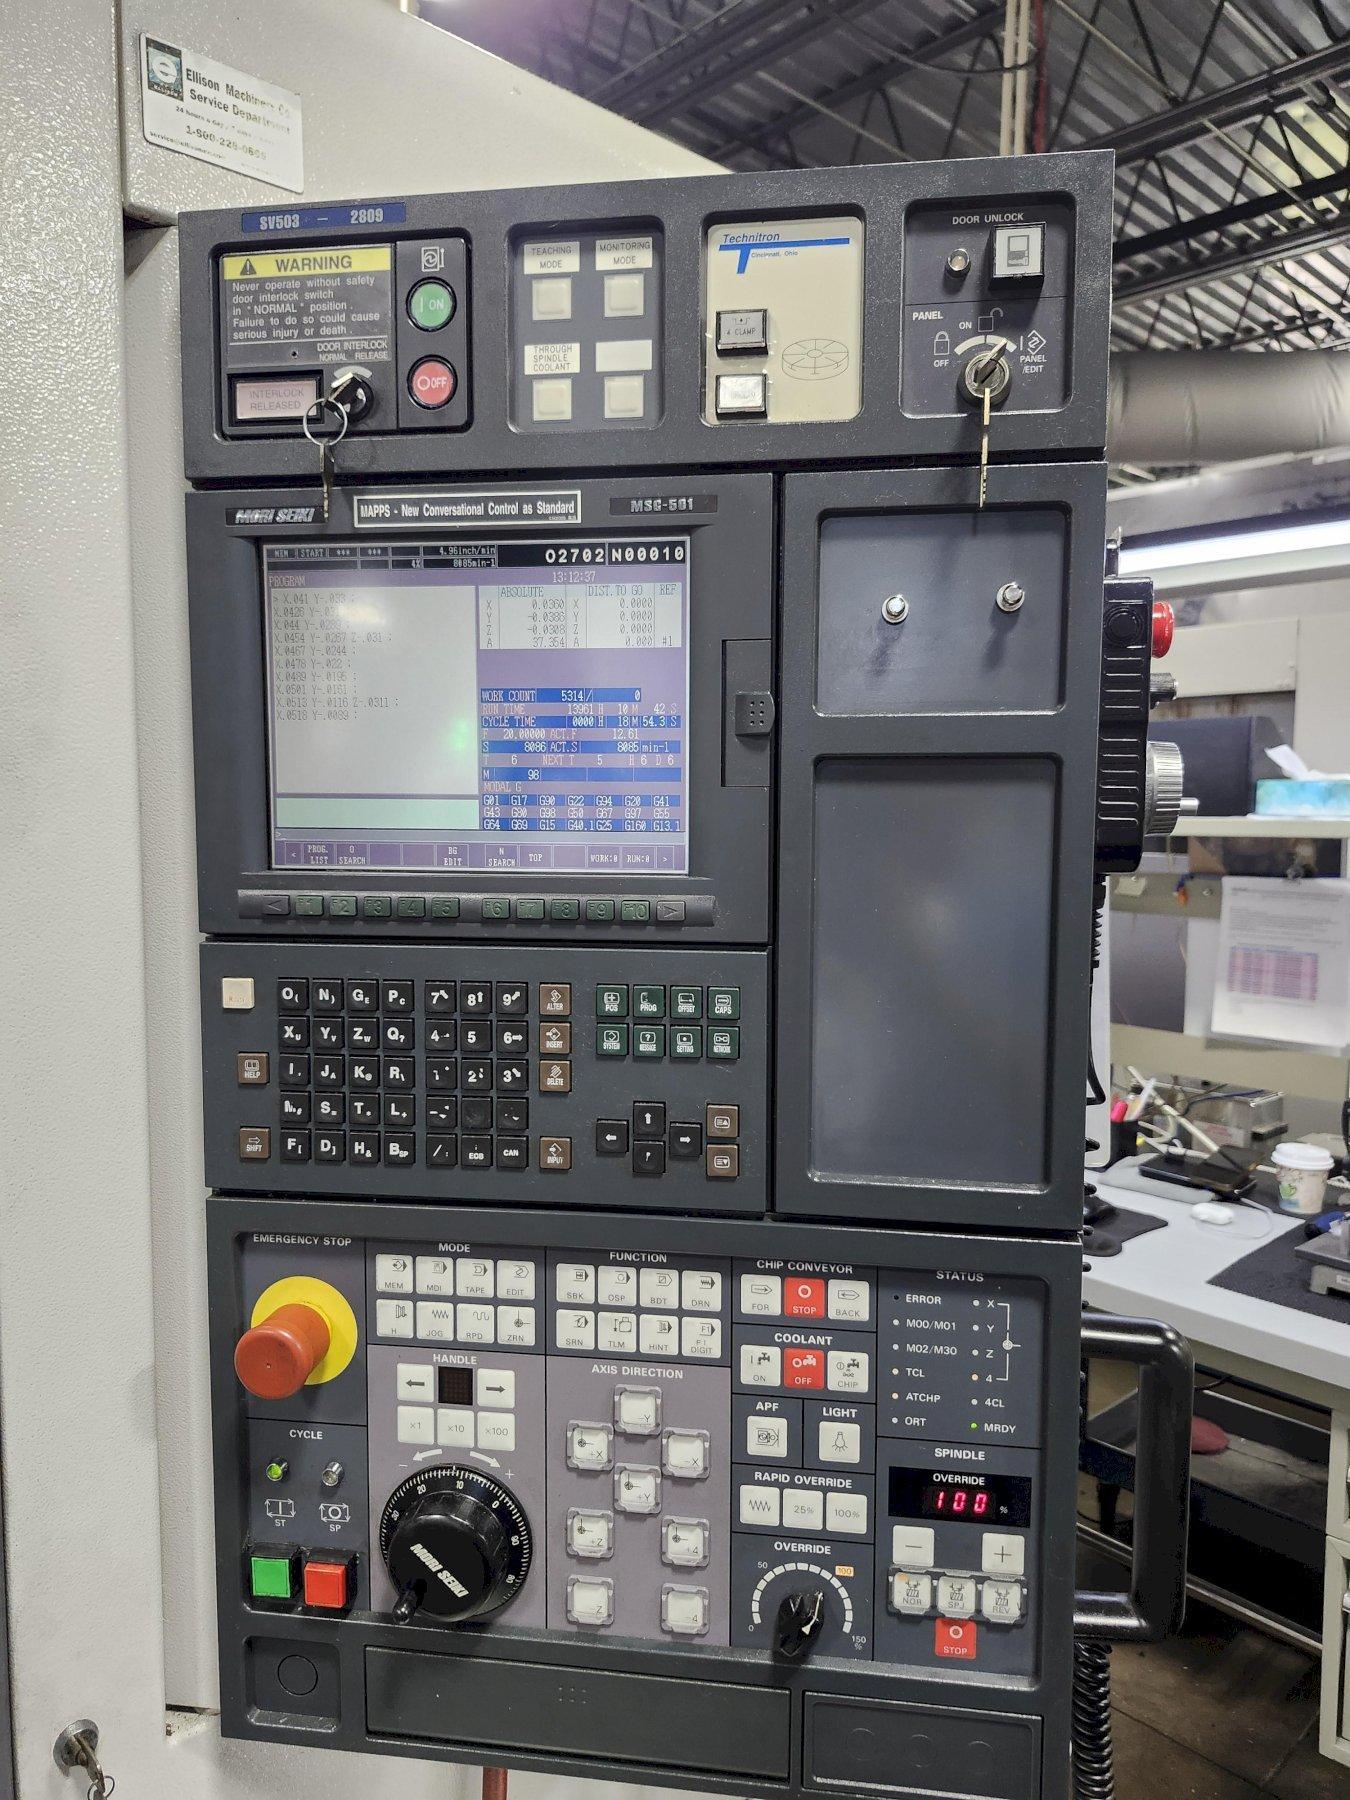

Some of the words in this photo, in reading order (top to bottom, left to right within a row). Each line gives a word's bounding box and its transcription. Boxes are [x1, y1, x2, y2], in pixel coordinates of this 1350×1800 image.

[185, 67, 220, 92] Ellison
[190, 88, 229, 113] Service
[260, 214, 300, 230] SV503
[350, 208, 384, 224] 2809
[952, 216, 980, 224] DOOR
[984, 212, 1024, 223] UNLOCK
[722, 232, 780, 244] Technitron
[531, 246, 572, 256] TEACHING
[600, 242, 650, 251] MONITORING
[276, 256, 352, 273] WARNING
[540, 260, 563, 268] MODE
[613, 256, 636, 265] MODE
[232, 282, 259, 292] Never
[265, 280, 300, 292] operate
[306, 276, 340, 287] without
[346, 276, 376, 287] safety
[232, 294, 254, 304] door
[259, 291, 299, 302] interlock
[304, 290, 334, 300] switch
[429, 300, 445, 310] ON
[232, 306, 242, 316] in
[912, 311, 944, 320] PANEL
[233, 317, 265, 328] Failure
[270, 316, 280, 326] to
[285, 316, 298, 325] do
[302, 316, 315, 324] so
[320, 312, 346, 324] could
[351, 312, 380, 322] cause
[958, 322, 972, 330] ON
[232, 330, 268, 340] serious
[272, 327, 299, 339] injury
[304, 328, 315, 336] or
[317, 342, 341, 352] DOOR
[344, 340, 388, 350] INTERLOCK
[534, 346, 572, 354] THROUGH
[319, 352, 348, 361] NORMAL
[355, 350, 388, 360] RELEASE
[533, 354, 568, 362] SPINDLE
[1020, 355, 1047, 364] PANEL
[533, 363, 570, 372] COOLANT
[934, 359, 950, 368] OFF
[1022, 365, 1044, 374] /EDIT
[431, 378, 448, 388] OFF
[250, 388, 304, 400] INTERLOCK
[250, 400, 302, 412] RELEASED
[360, 504, 391, 517] MAPPS
[401, 504, 420, 517] New
[423, 502, 484, 516] Conversational
[488, 501, 518, 516] Control
[522, 504, 533, 514] as
[536, 500, 575, 514] Standard
[630, 498, 694, 513] MSG-501
[235, 509, 274, 524] MORI
[275, 508, 316, 523] SEIKI
[274, 549, 289, 558] MEM
[300, 549, 325, 558] START
[611, 546, 685, 562] N00010
[268, 576, 306, 588] PROGRAM
[552, 571, 596, 583] 13:12:37
[500, 586, 544, 598] ABSOLUTE
[632, 585, 644, 596] GO
[659, 584, 676, 596] REF
[482, 690, 504, 700] WORK
[508, 690, 536, 700] COUNT
[482, 704, 499, 714] RUN
[504, 704, 525, 714] TIME
[568, 704, 594, 714] 13961
[482, 716, 509, 727] CYCLE
[514, 716, 536, 727] TIME
[642, 716, 666, 727] 54.3
[612, 729, 639, 740] 12.61
[550, 742, 578, 752] ACT.S
[511, 796, 528, 806] G17
[540, 796, 556, 806] G90
[568, 796, 584, 806] G22
[596, 796, 613, 806] G94
[624, 796, 641, 806] G20
[653, 796, 670, 806] G41
[310, 856, 328, 864] LIST
[338, 856, 366, 864] SEARCH
[444, 858, 462, 866] EDIT
[488, 859, 516, 867] SEARCH
[528, 854, 543, 862] TOP
[546, 1003, 564, 1011] ALTER
[605, 1004, 618, 1012] POS
[640, 1004, 657, 1012] PROG
[678, 1005, 695, 1014] OFFSET
[715, 1006, 732, 1015] CAPS
[603, 1042, 620, 1050] SYSTEM
[546, 1078, 564, 1086] DELETE
[246, 1144, 262, 1152] SHIFT
[253, 1233, 320, 1245] EMERGENCY
[324, 1236, 352, 1247] STOP
[438, 1242, 471, 1253] MODE
[609, 1251, 668, 1263] FUNCTION
[756, 1260, 784, 1270] CHIP
[788, 1261, 853, 1274] CONVEYOR
[936, 1270, 984, 1282] STATUS
[384, 1281, 404, 1290] MEM
[426, 1284, 442, 1292] MDI
[466, 1286, 485, 1294] TAPE
[506, 1288, 525, 1296] EDIT
[566, 1292, 584, 1300] SBK
[608, 1294, 626, 1302] OSP
[906, 1294, 942, 1305] ERROR
[752, 1303, 770, 1312] FOR
[792, 1305, 817, 1314] STOP
[835, 1308, 860, 1318] BACK
[906, 1318, 956, 1331] M00/M01
[426, 1328, 444, 1338] JOG
[466, 1332, 484, 1340] RPD
[507, 1334, 525, 1342] ZRN
[774, 1332, 834, 1346] COOLANT
[906, 1344, 958, 1356] M02/M30
[432, 1354, 478, 1366] HANDLE
[591, 1364, 618, 1374] AXIS
[622, 1366, 684, 1379] DIRECTION
[906, 1368, 926, 1378] TCL
[794, 1377, 812, 1385] OFF
[906, 1392, 941, 1403] ATCHP
[756, 1402, 780, 1412] APF
[984, 1398, 1006, 1408] 4CL
[822, 1407, 858, 1418] LIGHT
[904, 1416, 927, 1427] ORT
[984, 1423, 1017, 1434] MRDY
[289, 1430, 323, 1440] CYCLE
[934, 1447, 986, 1461] SPINDLE
[754, 1472, 790, 1484] RAPID
[794, 1475, 853, 1489] OVERRIDE
[932, 1473, 986, 1486] OVERRIDE
[936, 1490, 989, 1514] 100
[834, 1508, 860, 1519] 100%
[774, 1541, 832, 1555] OVERRIDE
[410, 1543, 443, 1573] MORI
[437, 1569, 470, 1598] SEIKI
[852, 1635, 867, 1644] 150
[943, 1645, 968, 1655] STOP
